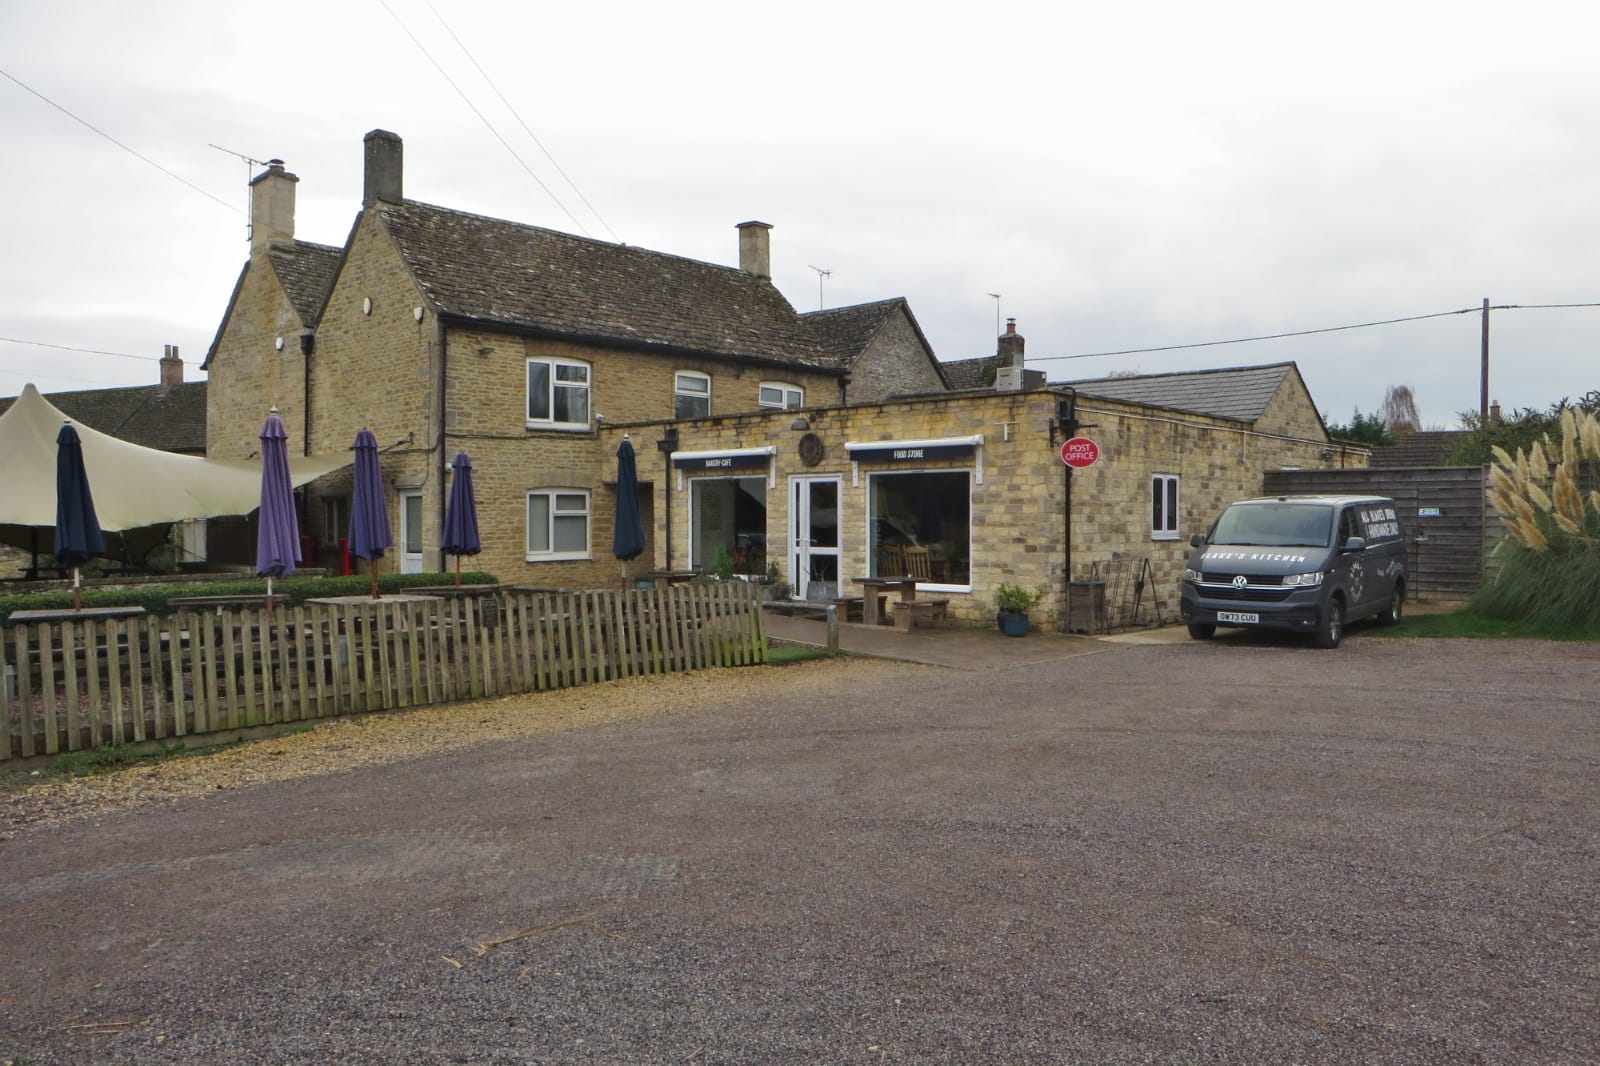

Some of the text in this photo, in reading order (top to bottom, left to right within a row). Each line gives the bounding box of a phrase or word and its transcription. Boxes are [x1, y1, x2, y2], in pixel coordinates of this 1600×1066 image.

[1069, 443, 1091, 453] POST
[893, 449, 924, 460] FOOD STORE
[1065, 451, 1095, 461] OFFICE
[1250, 553, 1306, 563] KITCHEN
